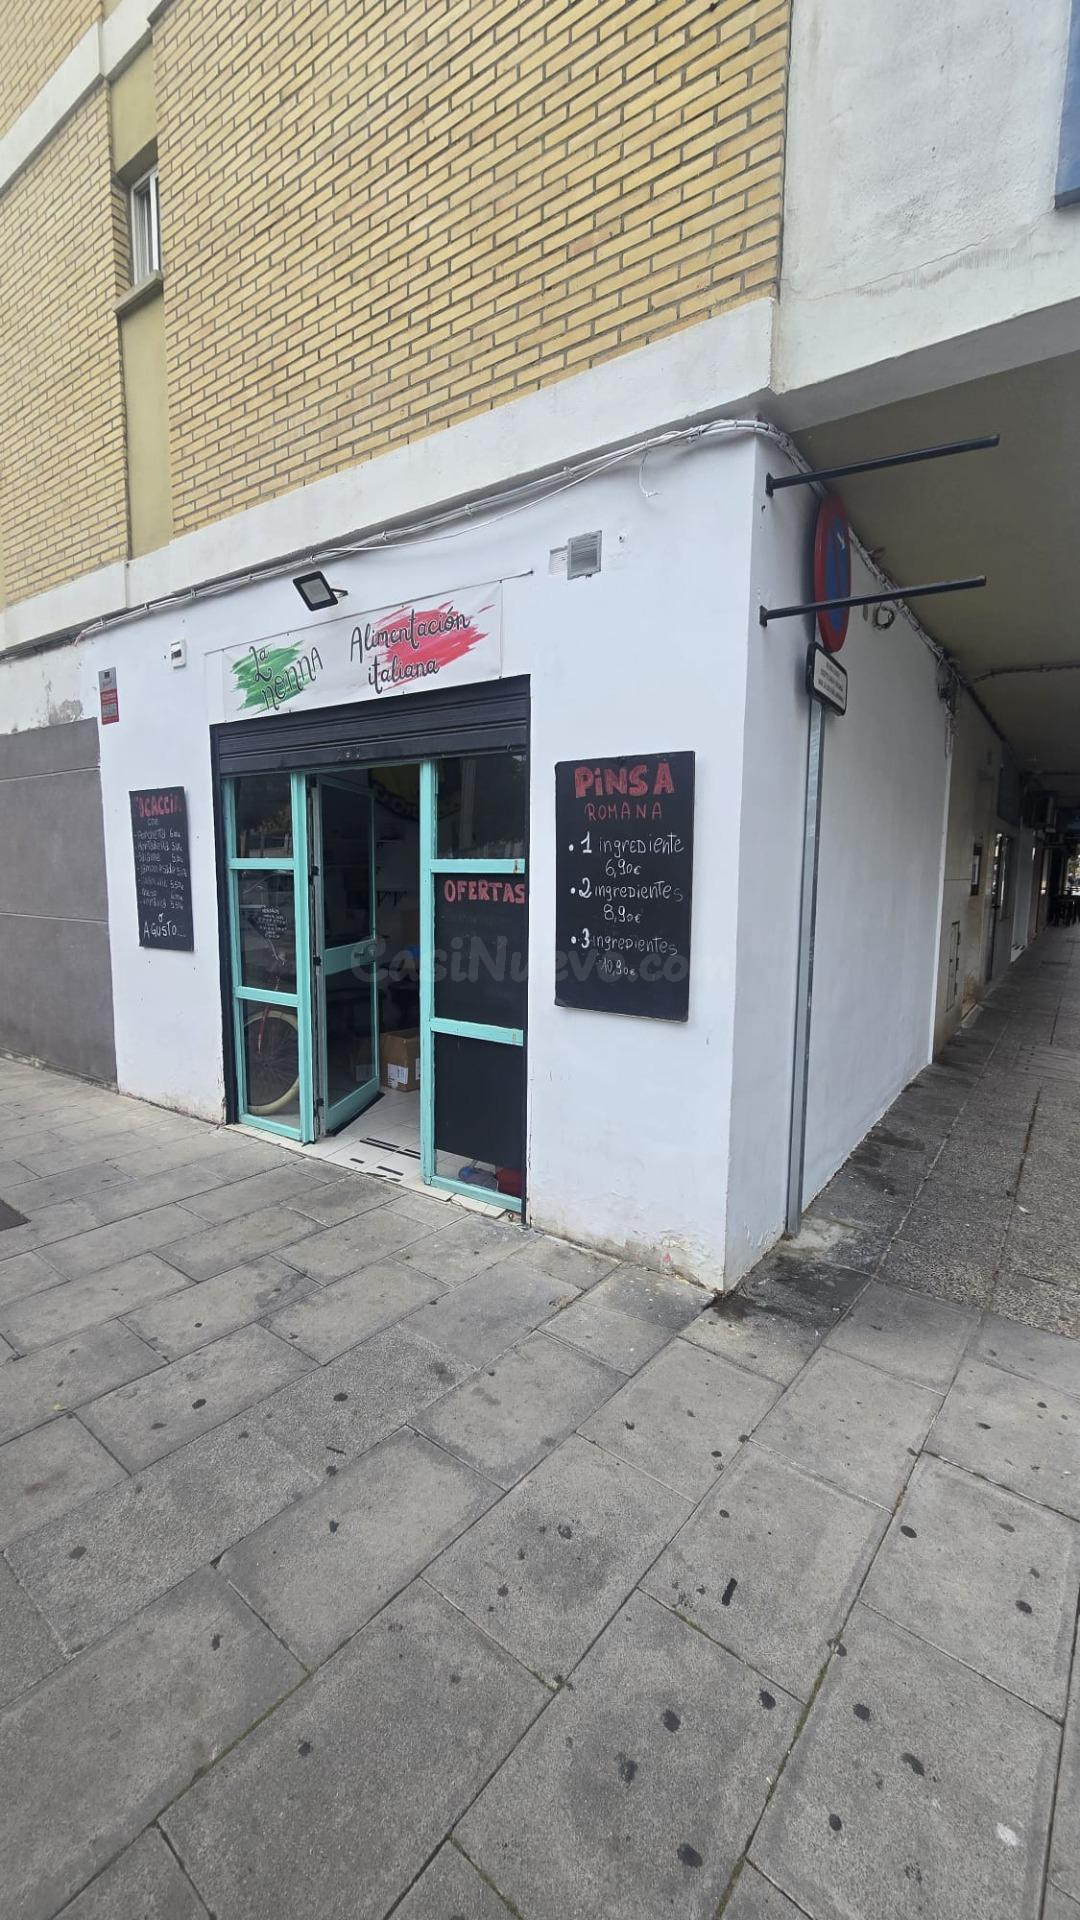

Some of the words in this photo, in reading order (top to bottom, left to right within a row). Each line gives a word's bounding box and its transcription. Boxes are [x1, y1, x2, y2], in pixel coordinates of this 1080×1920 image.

[350, 605, 470, 663] Alimentación
[249, 645, 272, 682] La
[368, 655, 441, 694] italiana
[584, 801, 663, 822] ROMANA
[581, 831, 592, 854] 1
[605, 859, 642, 878] 6,90€
[444, 880, 525, 904] OFERTAS
[578, 877, 592, 899] 2
[604, 904, 641, 923] 8,90€
[581, 928, 590, 949] 3
